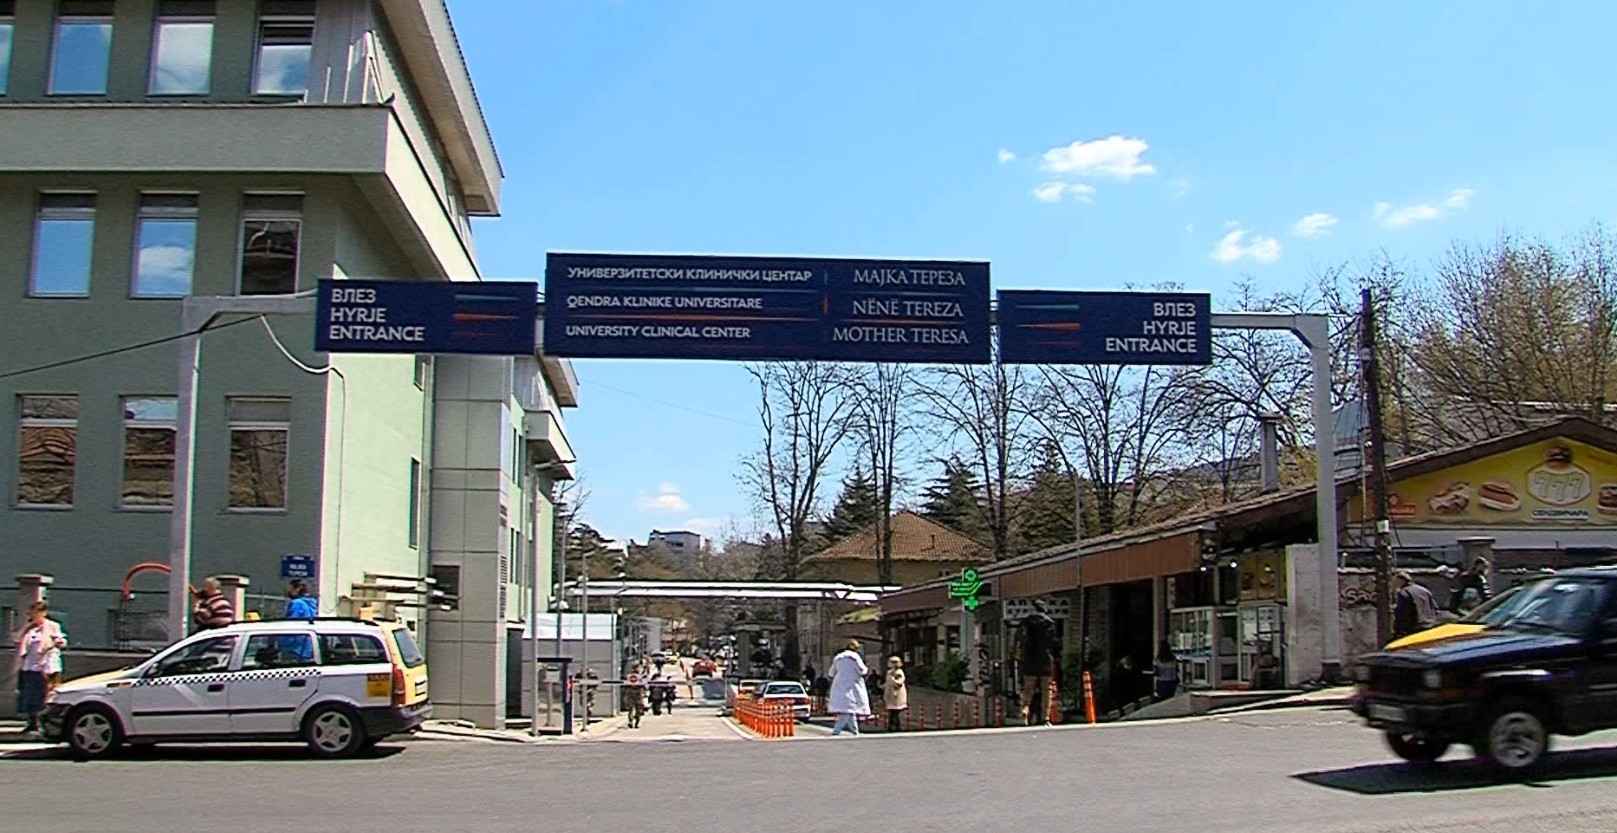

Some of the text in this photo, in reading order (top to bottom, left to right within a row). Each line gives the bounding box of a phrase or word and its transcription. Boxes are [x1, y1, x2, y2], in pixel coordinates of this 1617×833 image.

[568, 267, 813, 284] УНИВЕРЗИТЕТСКИ КЛИНИЧКИ ЦЕНТАР
[853, 268, 966, 287] МАЈКА ТЕРЕЗА
[331, 288, 377, 304] ВЛЕЗ
[567, 295, 763, 310] QENDRA KLINIKE UNIVERSITARE
[330, 307, 387, 323] HYRJE
[853, 299, 963, 317] NËNË TEREZA
[1152, 302, 1196, 317] ВЛЕЗ
[329, 325, 425, 342] ENTRANCE
[566, 325, 751, 338] UNIVERSITY CLINICAL CENTER
[833, 326, 969, 344] MOTHER TERESA
[1142, 320, 1196, 336] HYRJE
[1104, 337, 1197, 353] ENTRANCE
